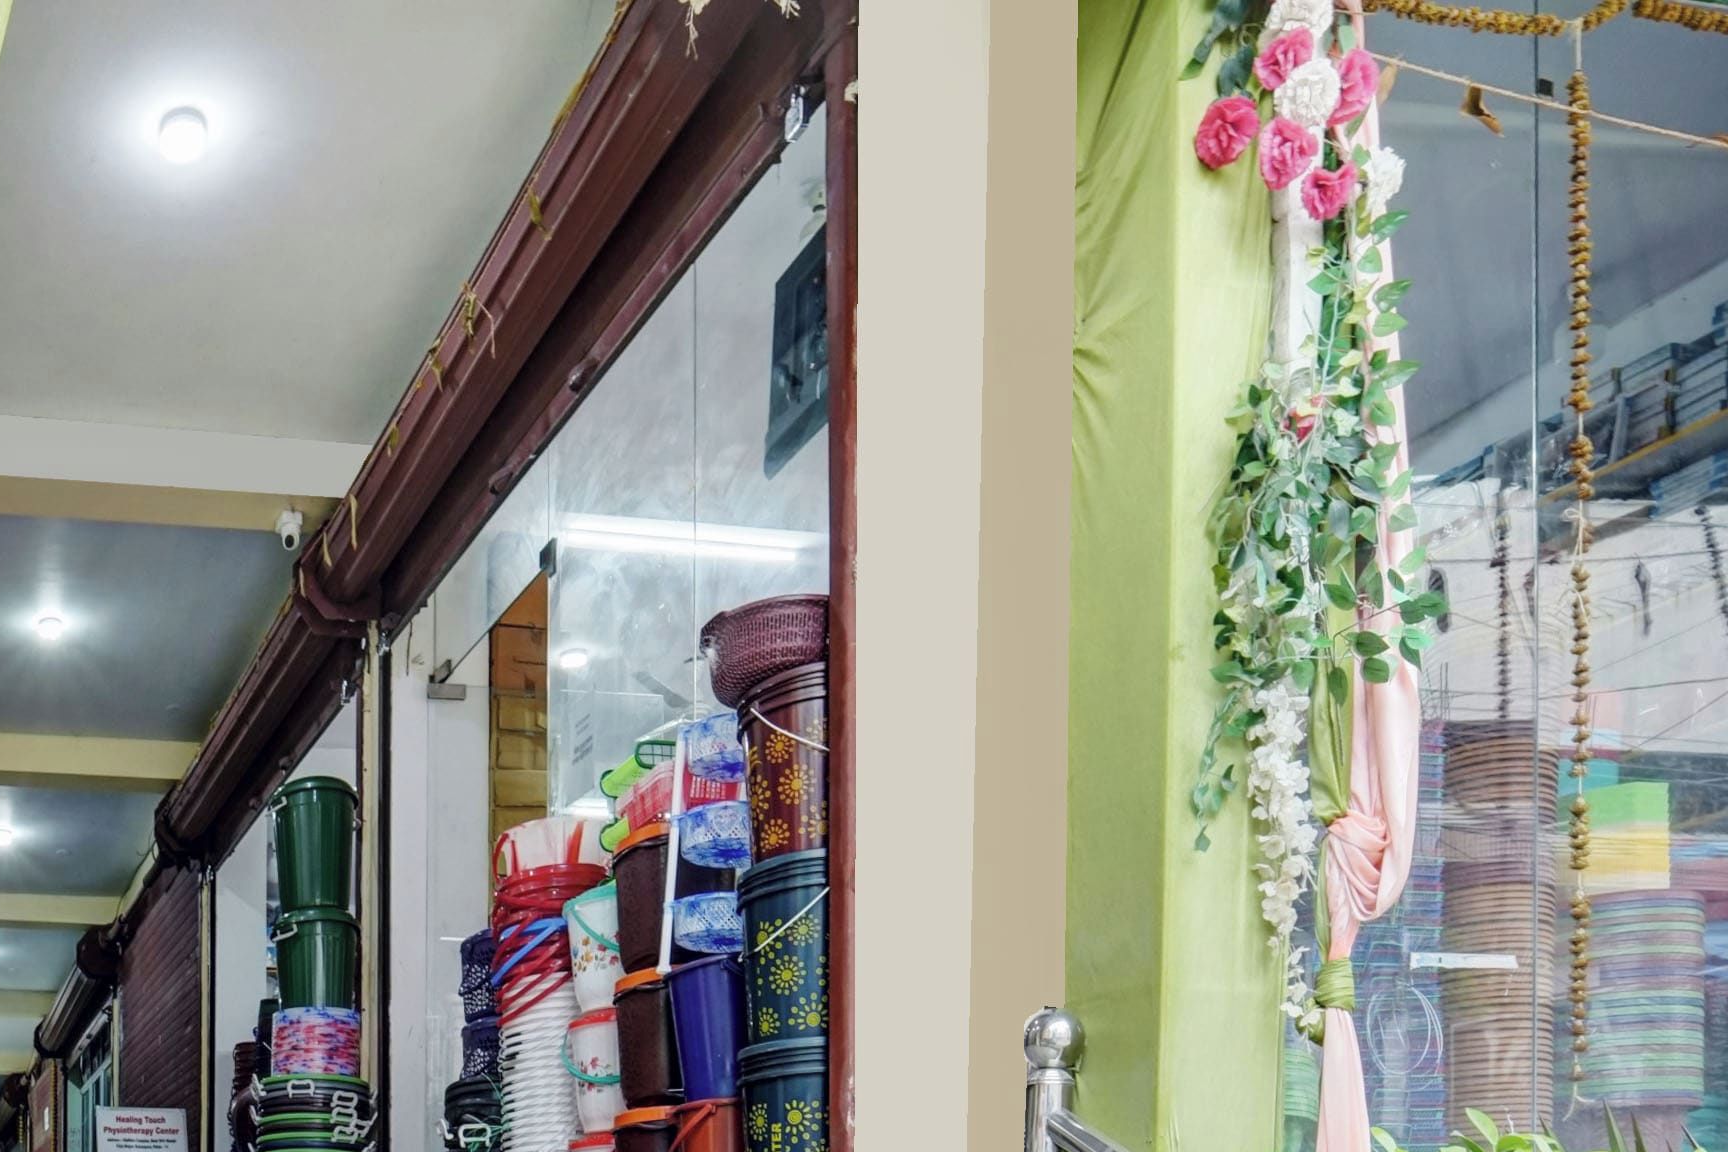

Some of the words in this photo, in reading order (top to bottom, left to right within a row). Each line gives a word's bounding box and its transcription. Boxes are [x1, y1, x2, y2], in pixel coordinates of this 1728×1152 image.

[116, 1116, 142, 1125] Healing
[104, 1126, 154, 1136] Physiotherapy
[155, 1127, 179, 1135] Center
